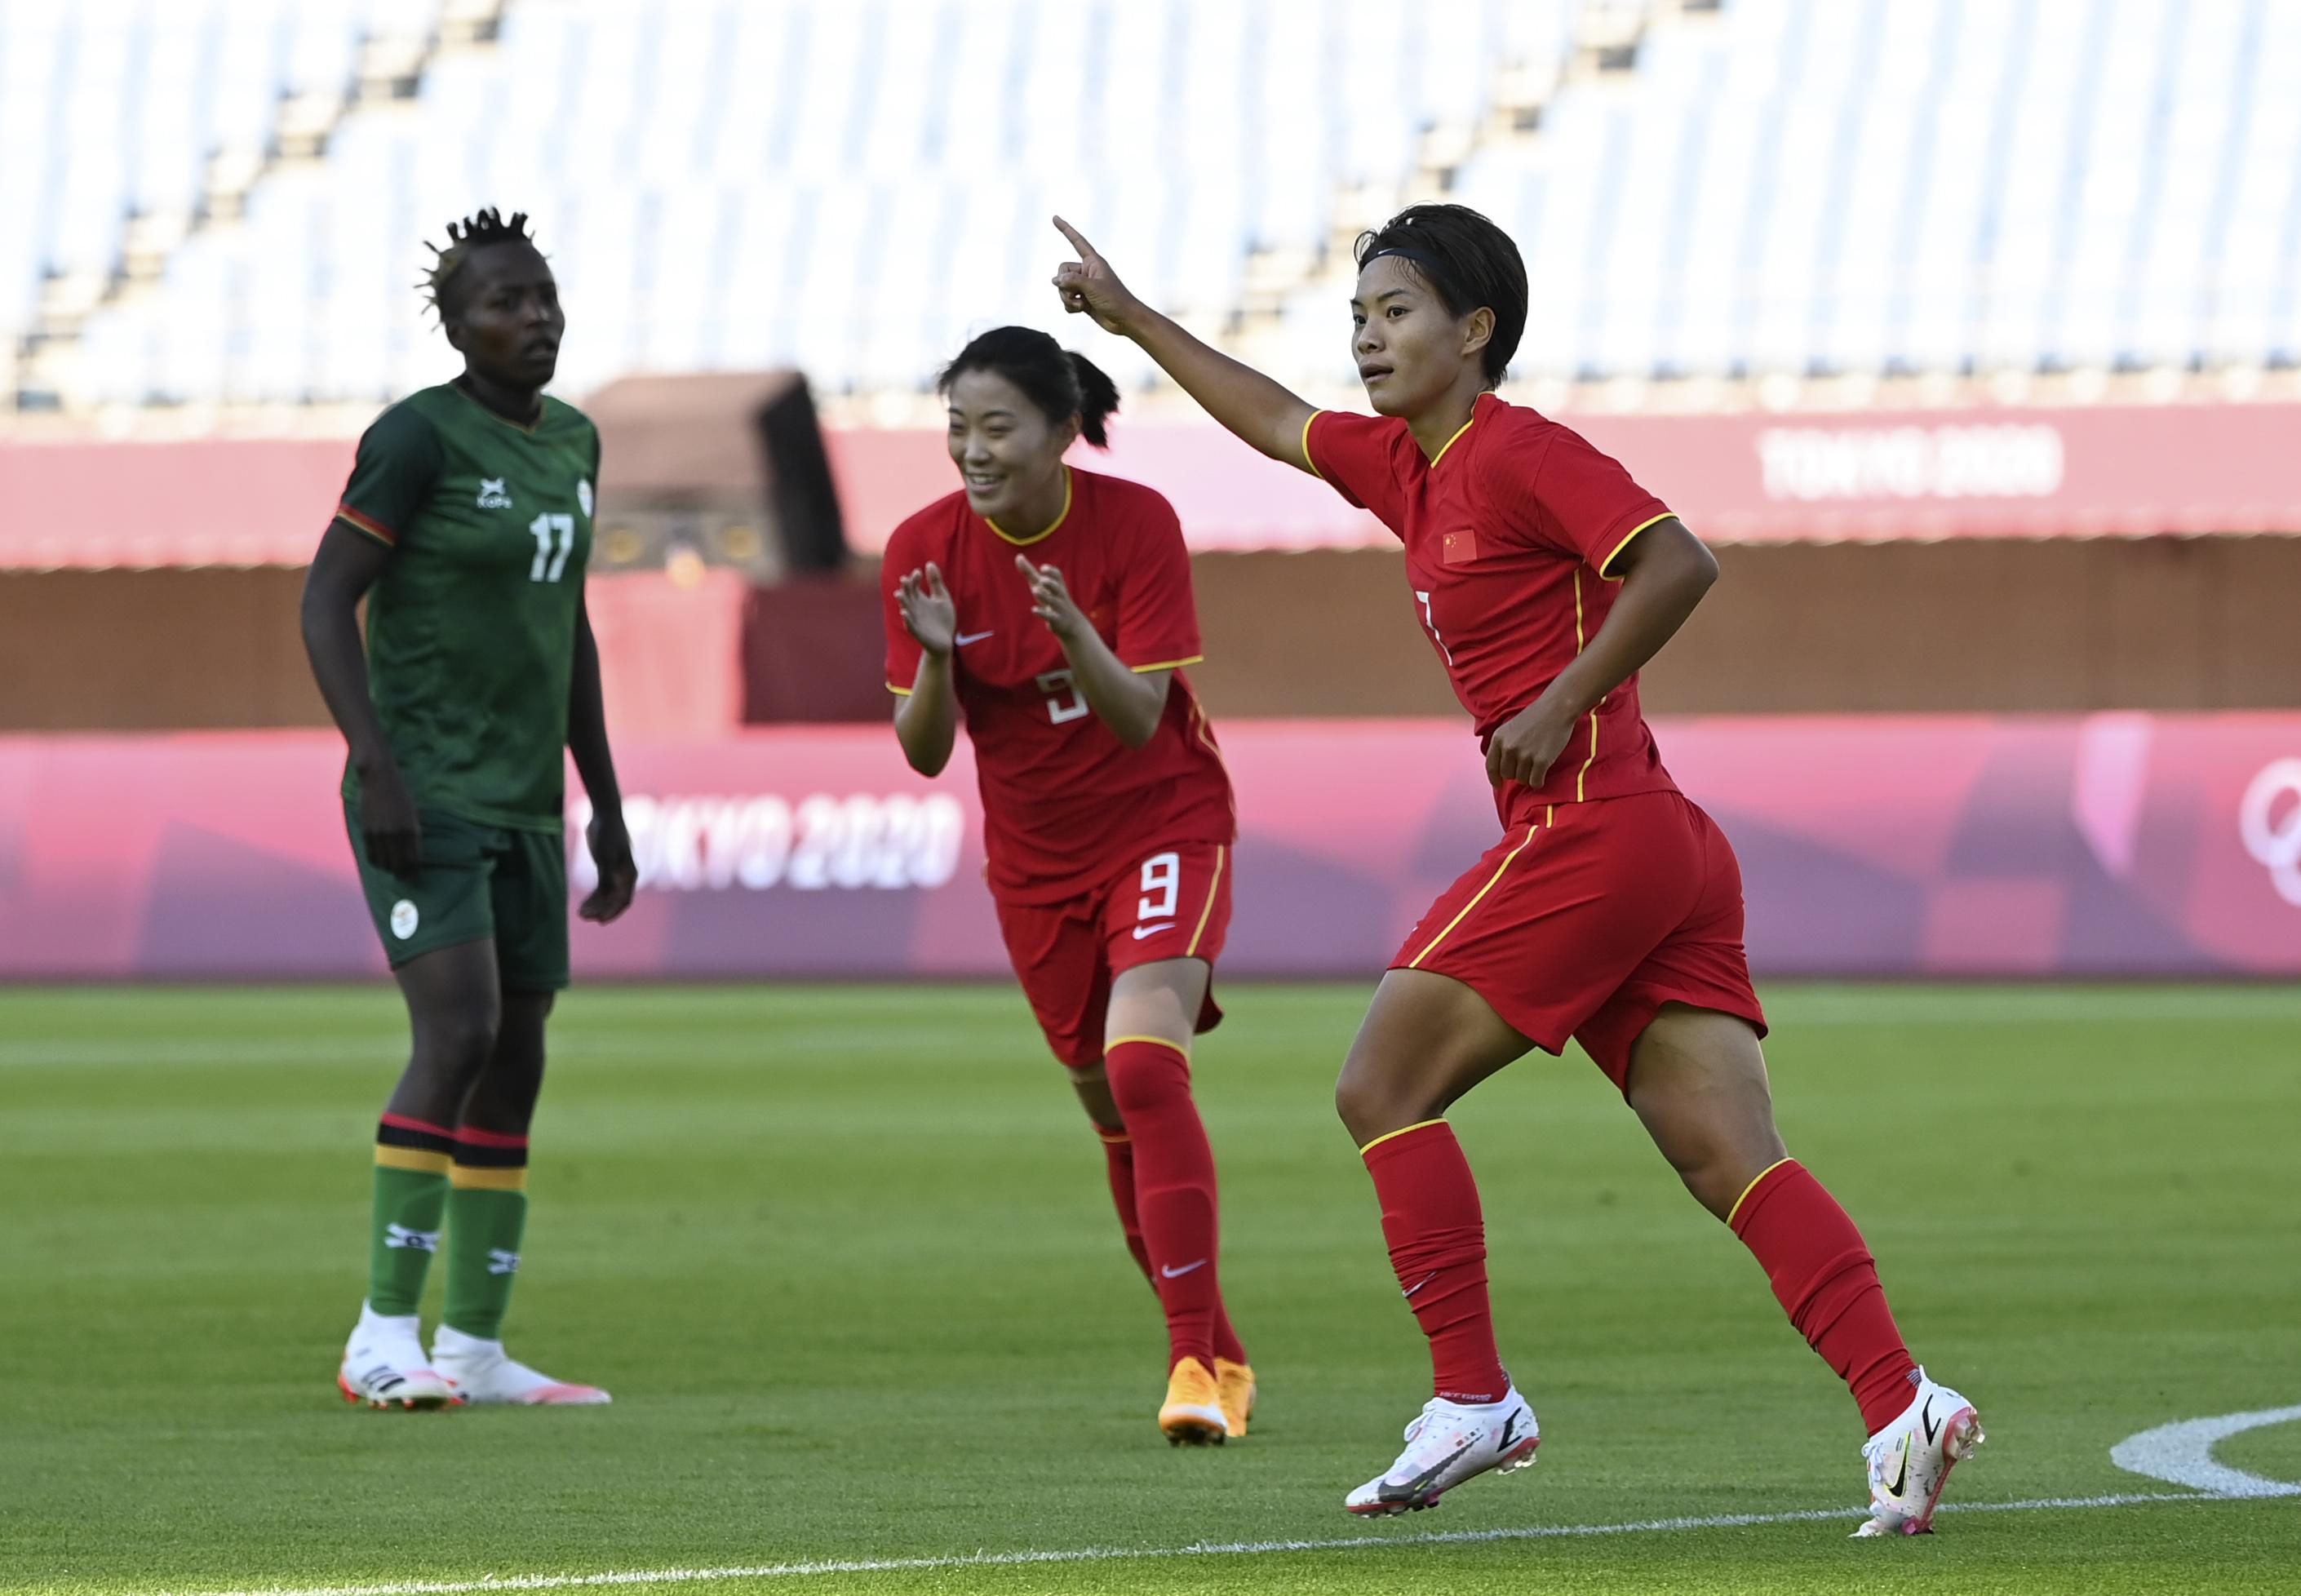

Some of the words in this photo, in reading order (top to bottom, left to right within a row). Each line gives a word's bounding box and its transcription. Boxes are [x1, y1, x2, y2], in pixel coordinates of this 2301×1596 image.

[528, 512, 574, 583] 17
[788, 792, 964, 889] 2020
[1137, 851, 1180, 921] 9
